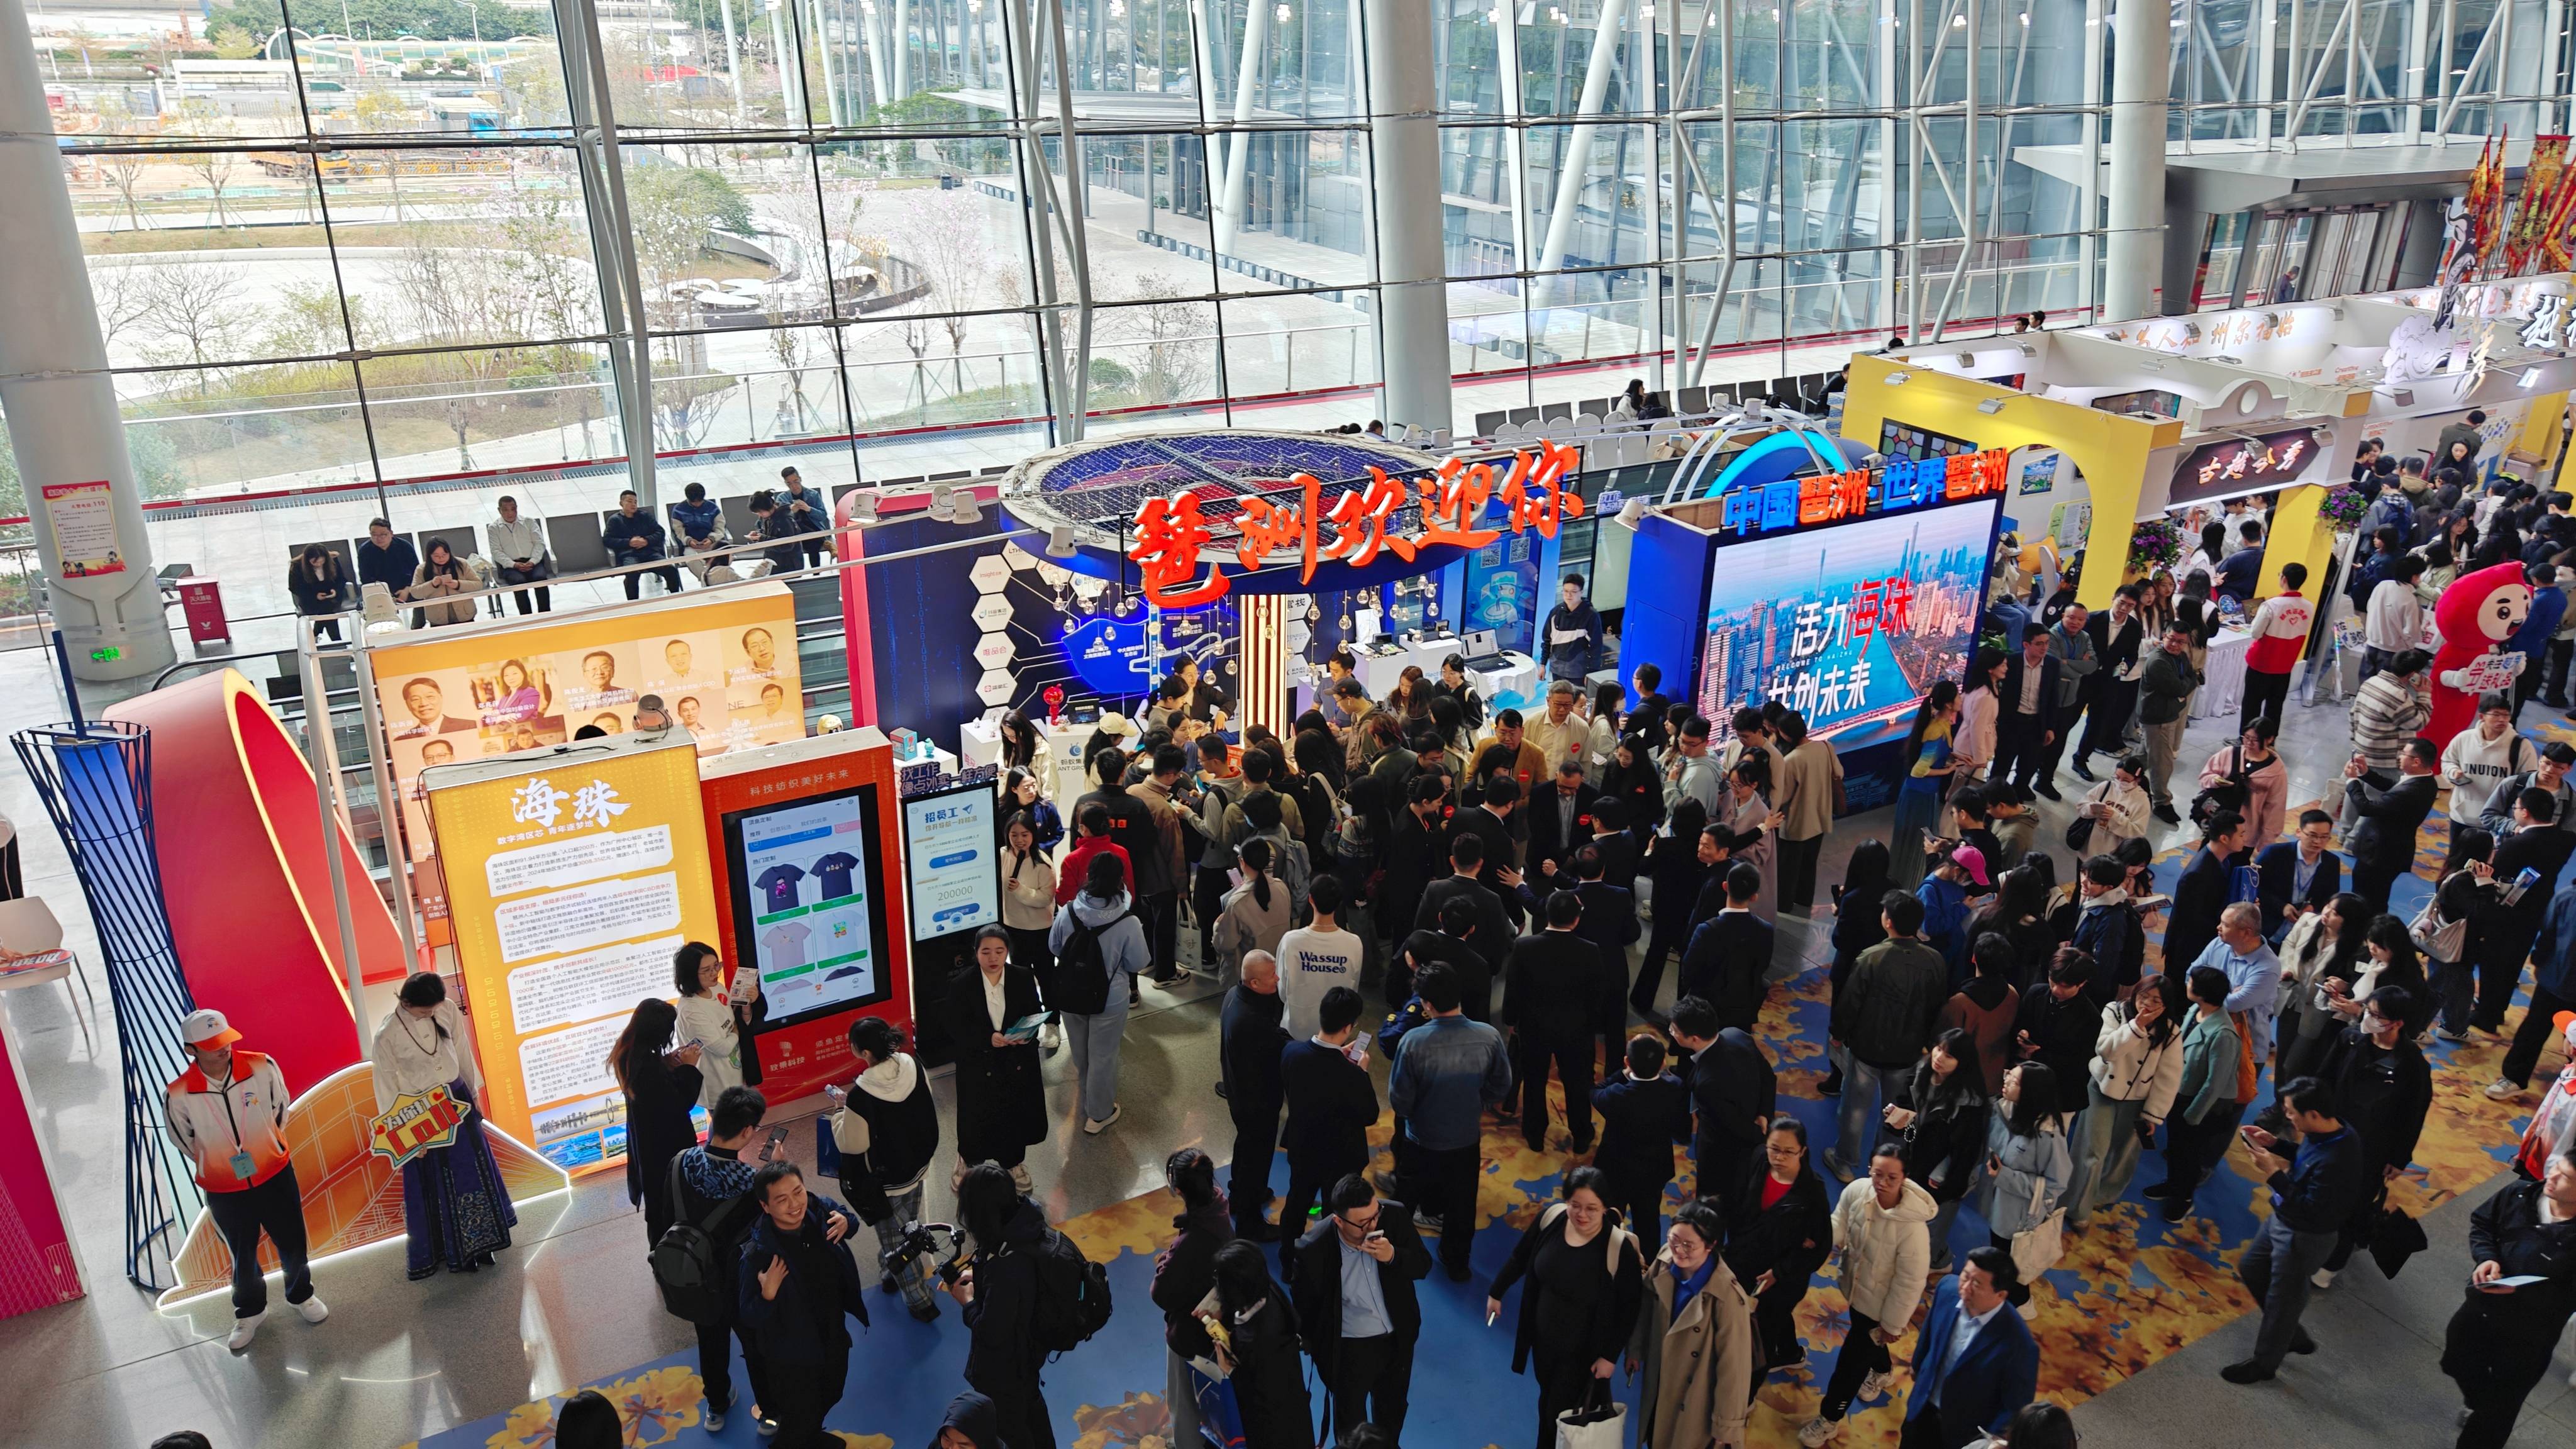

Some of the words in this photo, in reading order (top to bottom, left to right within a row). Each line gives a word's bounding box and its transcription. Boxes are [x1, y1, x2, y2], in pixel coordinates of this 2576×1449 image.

[1724, 447, 2007, 535] 中国琶洲·世界琶洲
[1128, 438, 1584, 608] 琶洲欢迎你
[1790, 571, 1913, 658] 活力海珠
[983, 647, 1007, 655] 唯品会
[750, 769, 850, 796] 科技纺织美好未来
[901, 763, 939, 781] 找工作
[902, 765, 997, 796] 像点外卖一样方便
[511, 777, 632, 828] 海珠
[925, 808, 958, 823] 招员工
[497, 830, 543, 845] 数字湾区芯
[548, 820, 594, 836] 青年逐梦地
[753, 855, 776, 865] 热门定制
[937, 886, 973, 901] 200000
[1299, 951, 1347, 966] Wassup
[382, 1095, 431, 1131] 为你打
[386, 1098, 461, 1157] Call
